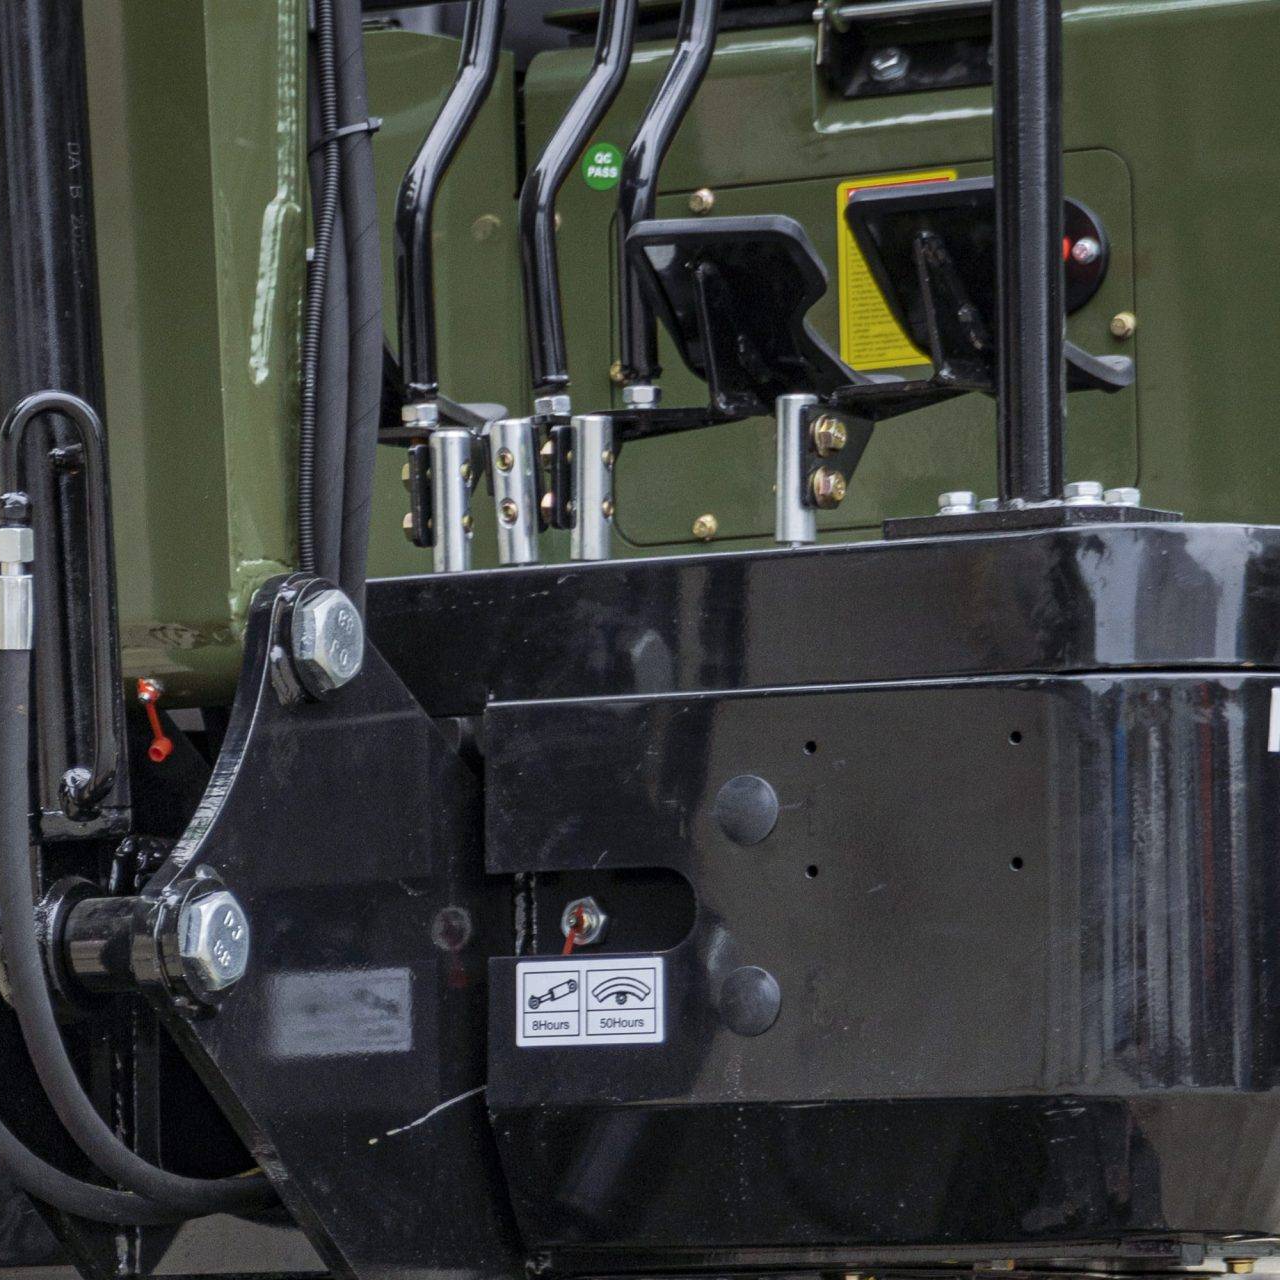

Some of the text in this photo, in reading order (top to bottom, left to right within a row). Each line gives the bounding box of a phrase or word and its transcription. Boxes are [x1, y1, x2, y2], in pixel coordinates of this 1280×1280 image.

[594, 151, 613, 164] QC
[587, 165, 618, 178] PASS
[532, 1020, 570, 1031] 8Hours
[599, 1017, 645, 1029] 50Hours
